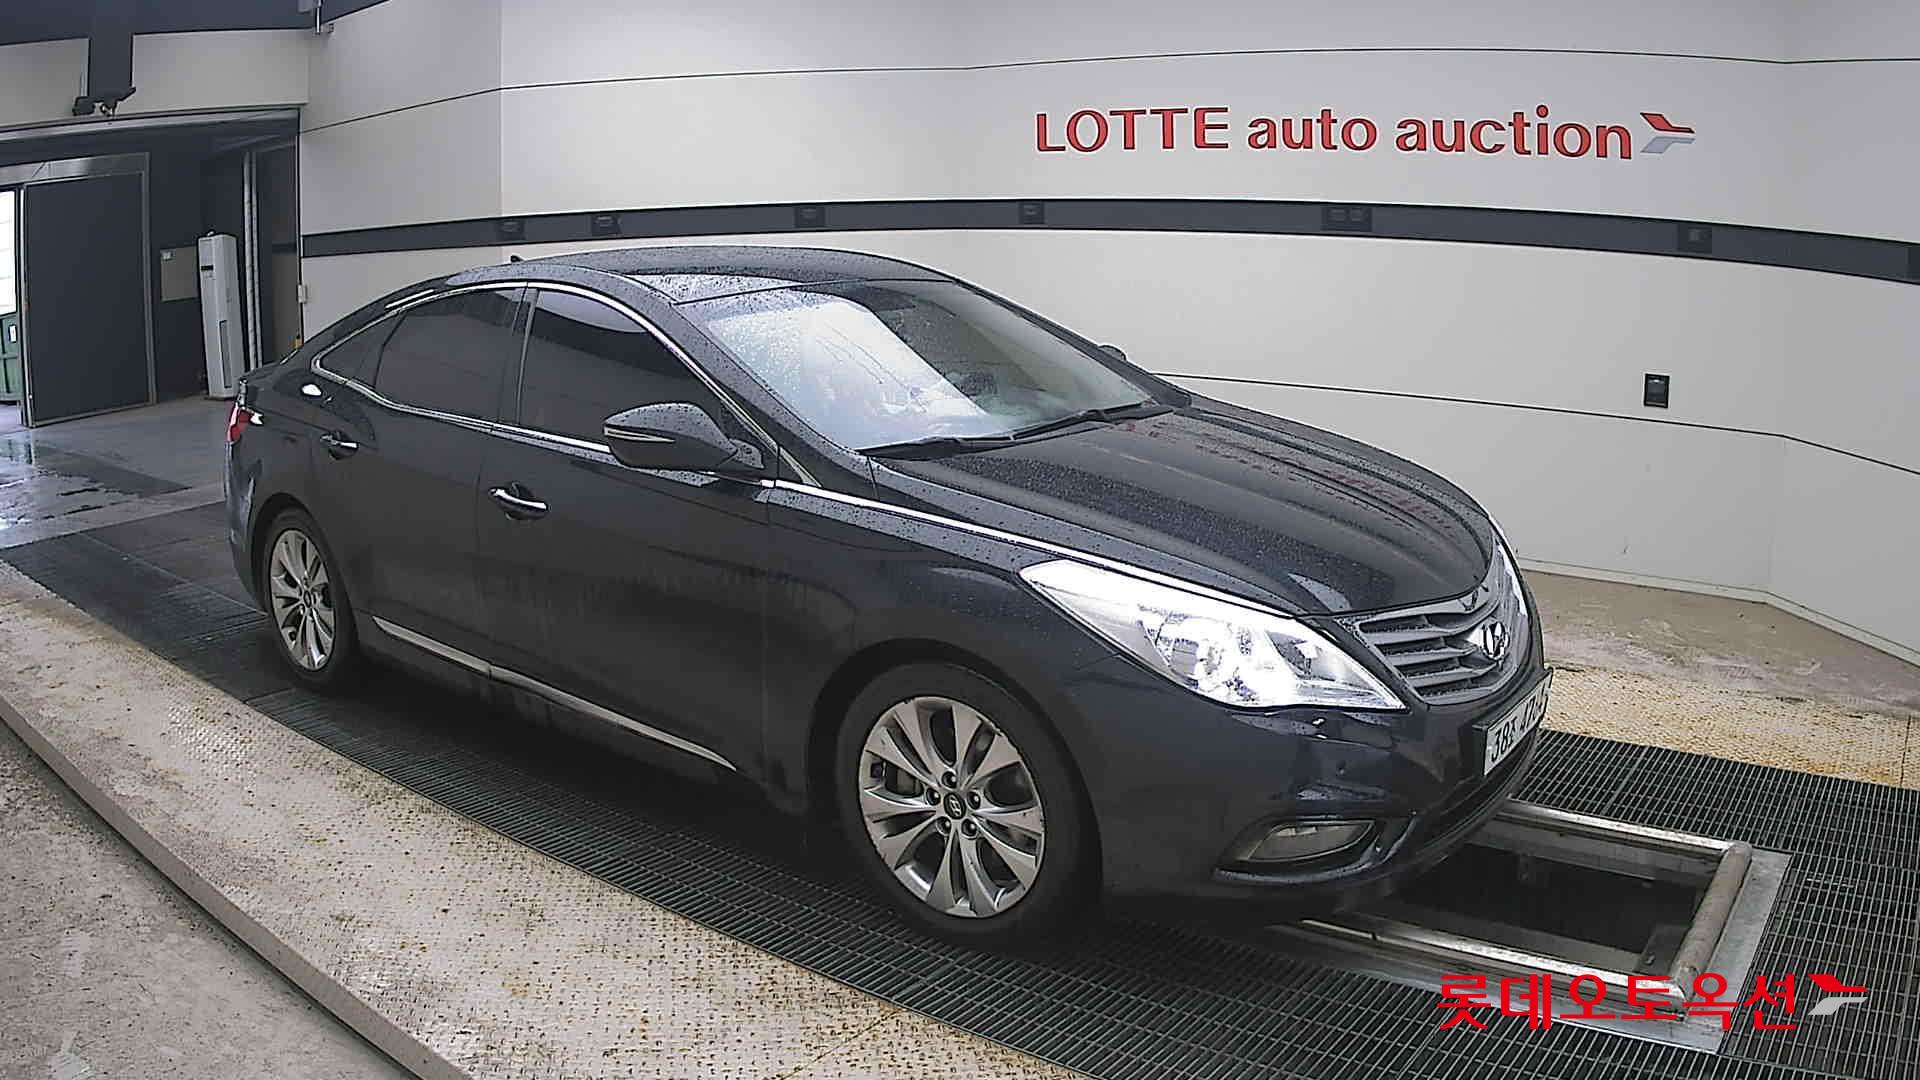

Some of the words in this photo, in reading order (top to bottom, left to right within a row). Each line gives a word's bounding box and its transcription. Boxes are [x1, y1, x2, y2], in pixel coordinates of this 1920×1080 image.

[1037, 107, 1230, 152] LOTTE
[1247, 109, 1377, 151] auto
[1396, 106, 1632, 159] auction
